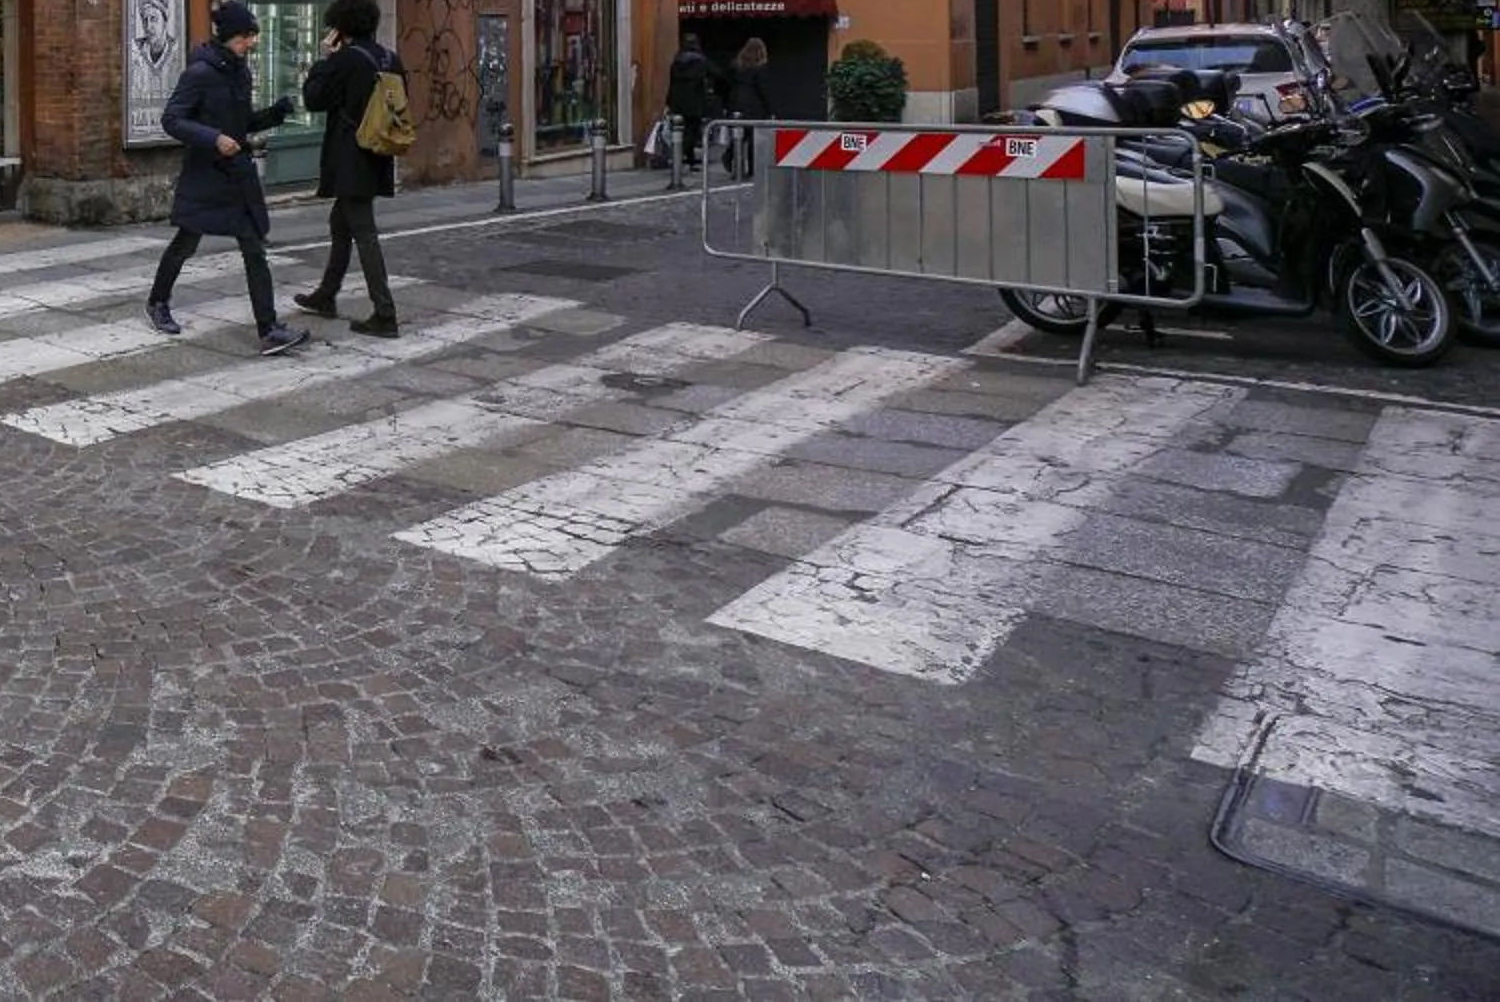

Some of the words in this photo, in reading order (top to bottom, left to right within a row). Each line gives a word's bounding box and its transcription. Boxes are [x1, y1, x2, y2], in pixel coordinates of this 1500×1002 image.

[711, 2, 785, 12] delicatezze
[844, 136, 864, 149] BNE
[1009, 141, 1035, 155] BNE
